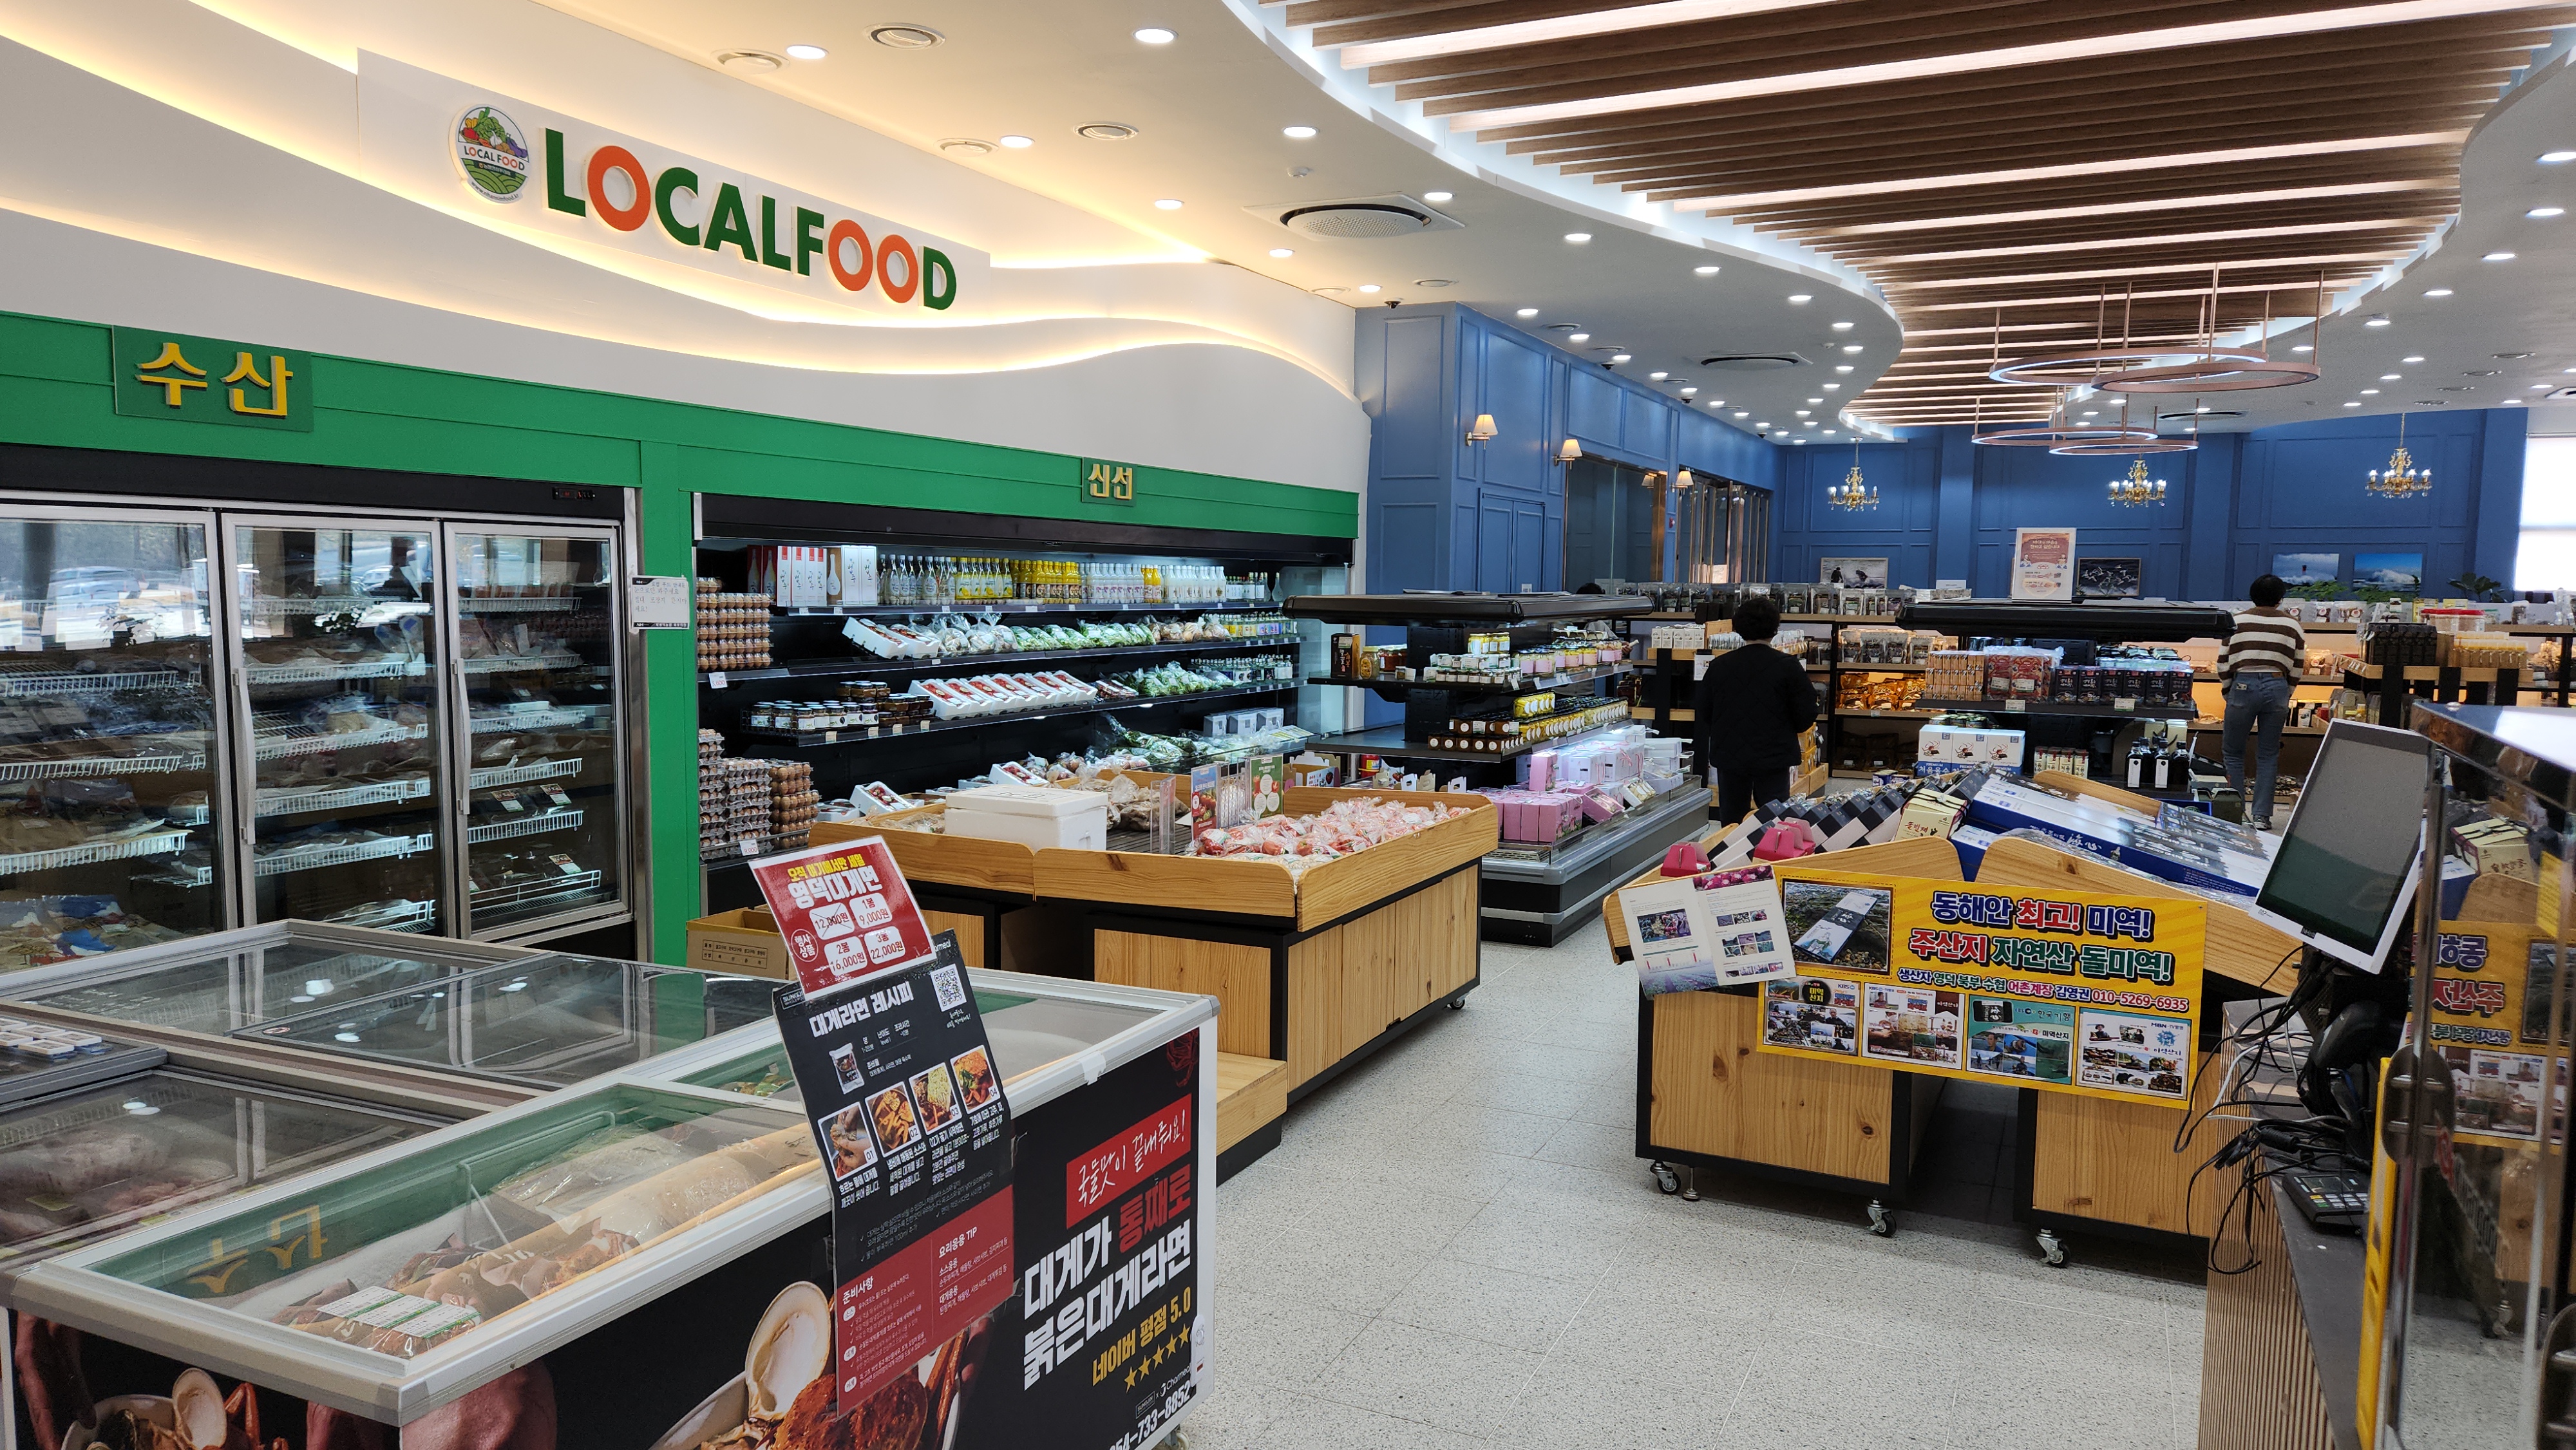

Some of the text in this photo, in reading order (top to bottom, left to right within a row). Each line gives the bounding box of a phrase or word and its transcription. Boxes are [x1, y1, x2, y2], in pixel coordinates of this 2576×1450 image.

[464, 146, 495, 162] LOCAL
[497, 154, 525, 171] FOOD
[544, 127, 956, 310] LOCALFOOD
[136, 343, 293, 418] 수산
[1088, 463, 1133, 500] 신선
[787, 854, 866, 882] 오직 여기에서만 세일
[788, 865, 883, 909] 영덕대게면
[861, 898, 875, 910] 1봉
[1932, 891, 2152, 938] 동해안 최고! 미역!
[859, 909, 890, 928] 9,000원
[794, 934, 811, 947] 행사
[799, 945, 816, 958] 상품
[837, 932, 889, 954] 2봉 3봉
[1909, 928, 2172, 981] 주산지 자연산 돌미역!
[830, 940, 904, 972] 16,000원 22,000원
[1810, 987, 1824, 995] 미역
[1898, 968, 2188, 1012] 생산자 영덕 북부 수협 어촌계장 김영권 010-5269-6935
[808, 981, 914, 1038] 대게라면 레시피
[2038, 1010, 2071, 1022] 한국기행
[2042, 1030, 2069, 1039] 미역산지
[2154, 1047, 2181, 1056] 미역산지
[989, 1089, 997, 1098] 04
[952, 1107, 959, 1116] 03
[910, 1128, 918, 1138] 02
[866, 1151, 875, 1160] 01
[1079, 1109, 1186, 1207] 국물맛이 끝내줘요!
[939, 1227, 978, 1259] 요리응용 TIP
[1025, 1216, 1112, 1320] 대게가
[1119, 1163, 1191, 1253] 통째로
[939, 1257, 958, 1277] 소스응용
[842, 1276, 874, 1305] 준비사항
[939, 1285, 958, 1304] 대게응용
[1024, 1218, 1190, 1391] 붉은대게라면
[1092, 1286, 1191, 1386] 네이버 평점 5.0
[1110, 1380, 1191, 1450] 54-733-8852
